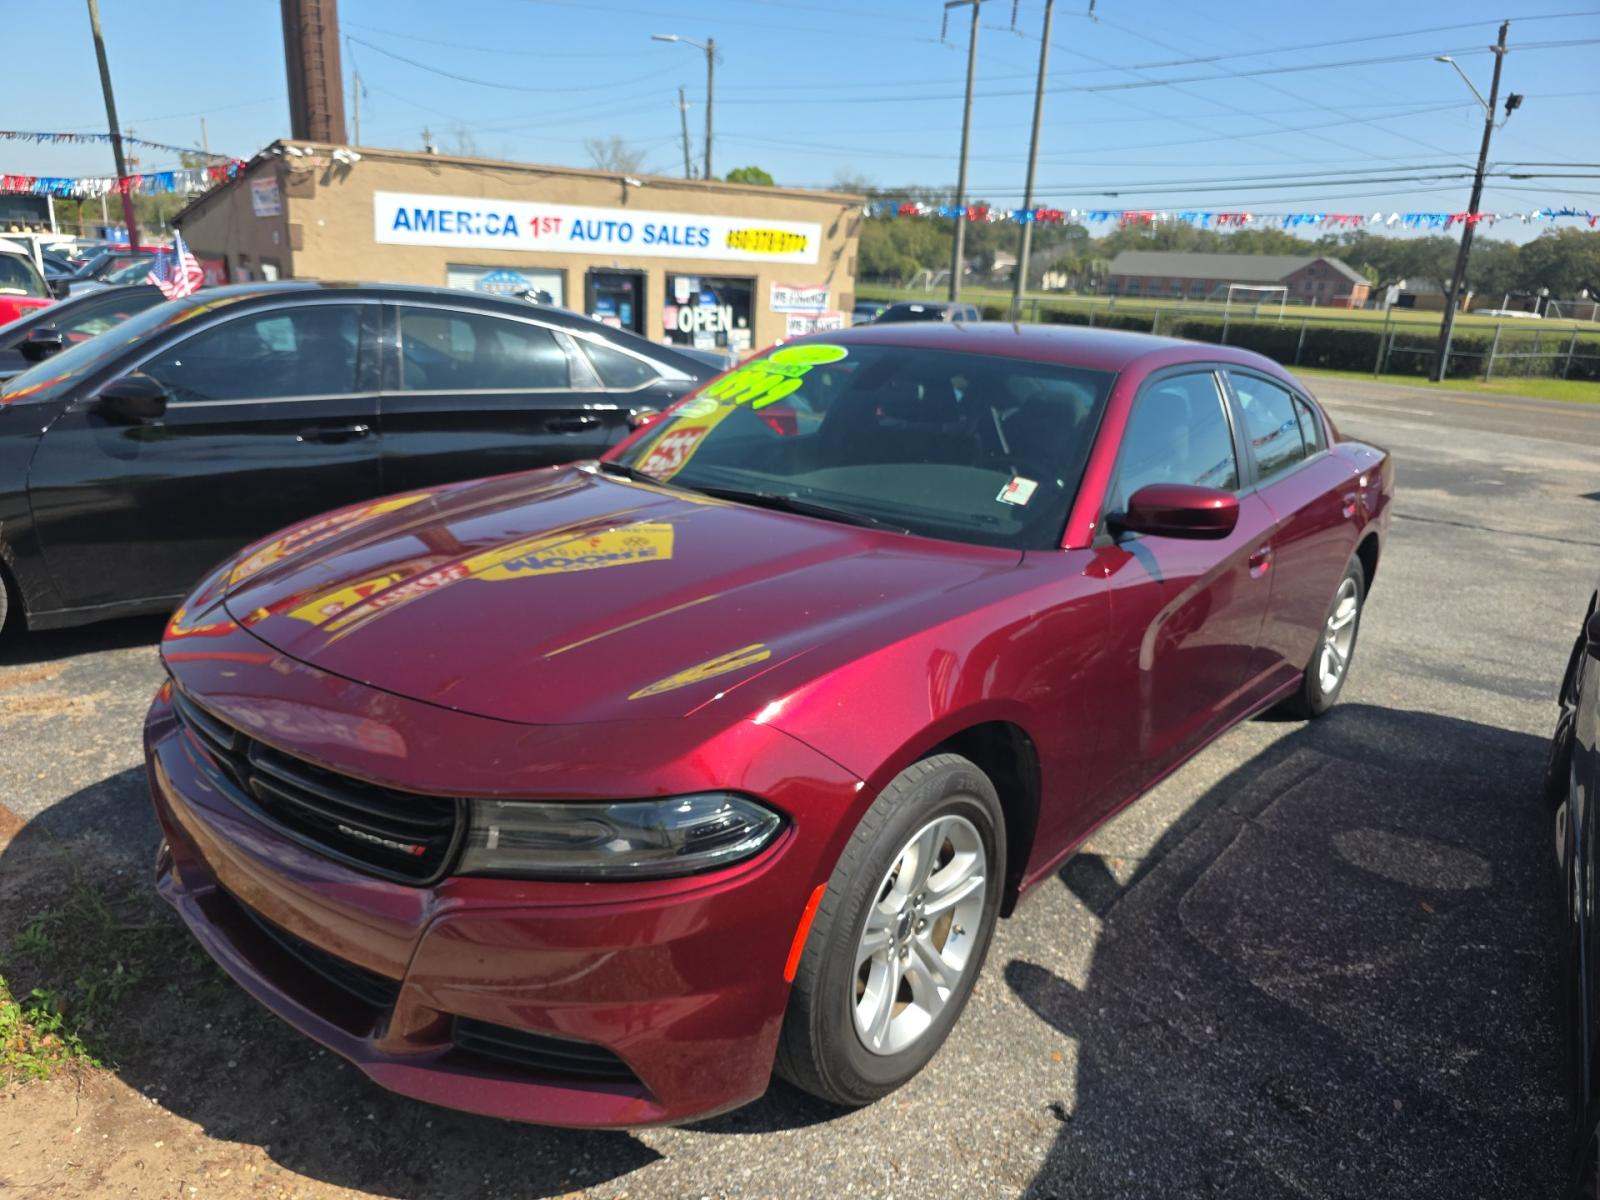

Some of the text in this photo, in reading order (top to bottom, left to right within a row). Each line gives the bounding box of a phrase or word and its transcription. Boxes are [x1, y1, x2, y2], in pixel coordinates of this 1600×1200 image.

[393, 207, 519, 237] AMERICA
[530, 216, 563, 239] 1ST
[570, 219, 633, 242] AUTO
[643, 224, 711, 248] SALES
[678, 304, 733, 333] OPEN
